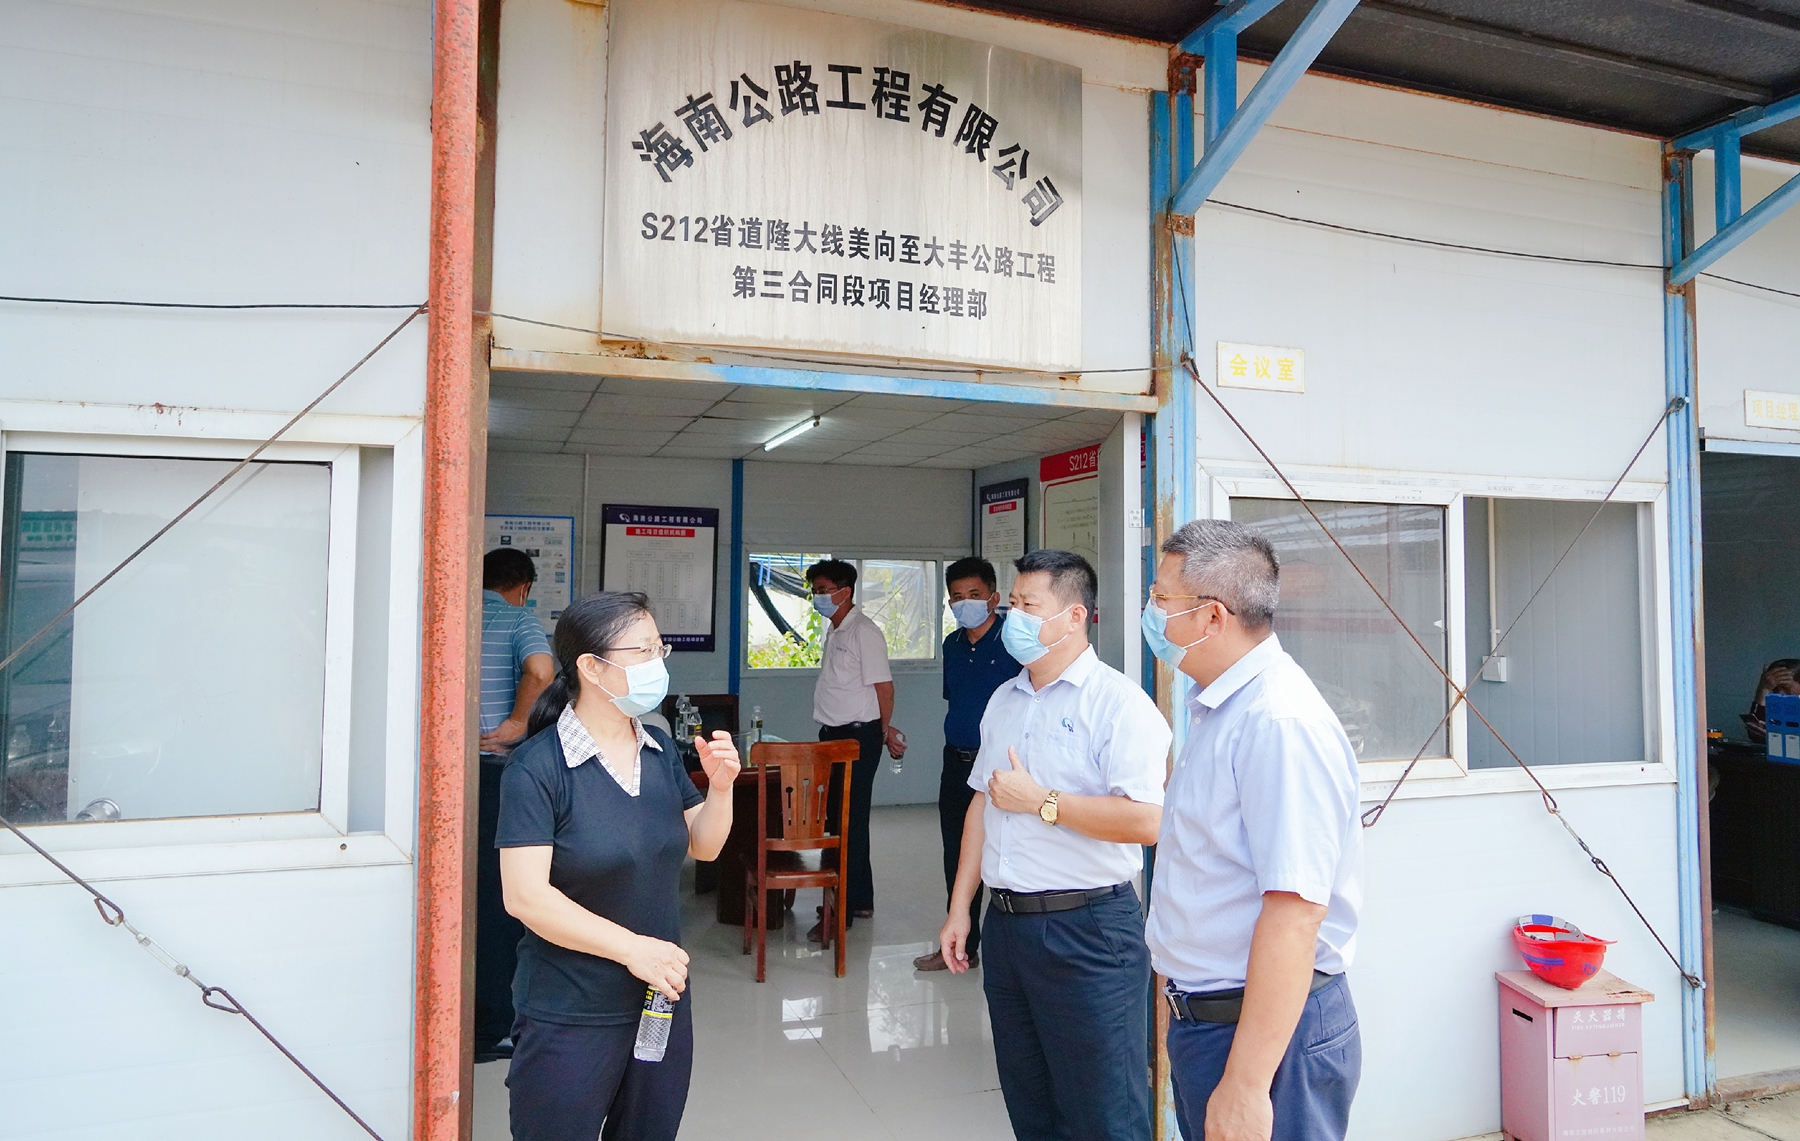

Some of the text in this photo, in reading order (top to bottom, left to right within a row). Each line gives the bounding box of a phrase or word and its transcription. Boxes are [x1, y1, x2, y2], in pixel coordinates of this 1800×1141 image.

[631, 60, 1064, 229] 海南公路工程有限公司
[641, 212, 1056, 285] S212省道隆大线美向至大丰公路工程
[732, 265, 988, 320] 第三合同段项目经理部
[1229, 353, 1295, 381] 会议室
[1069, 450, 1099, 471] S212省
[1571, 1085, 1627, 1107] 火警119
